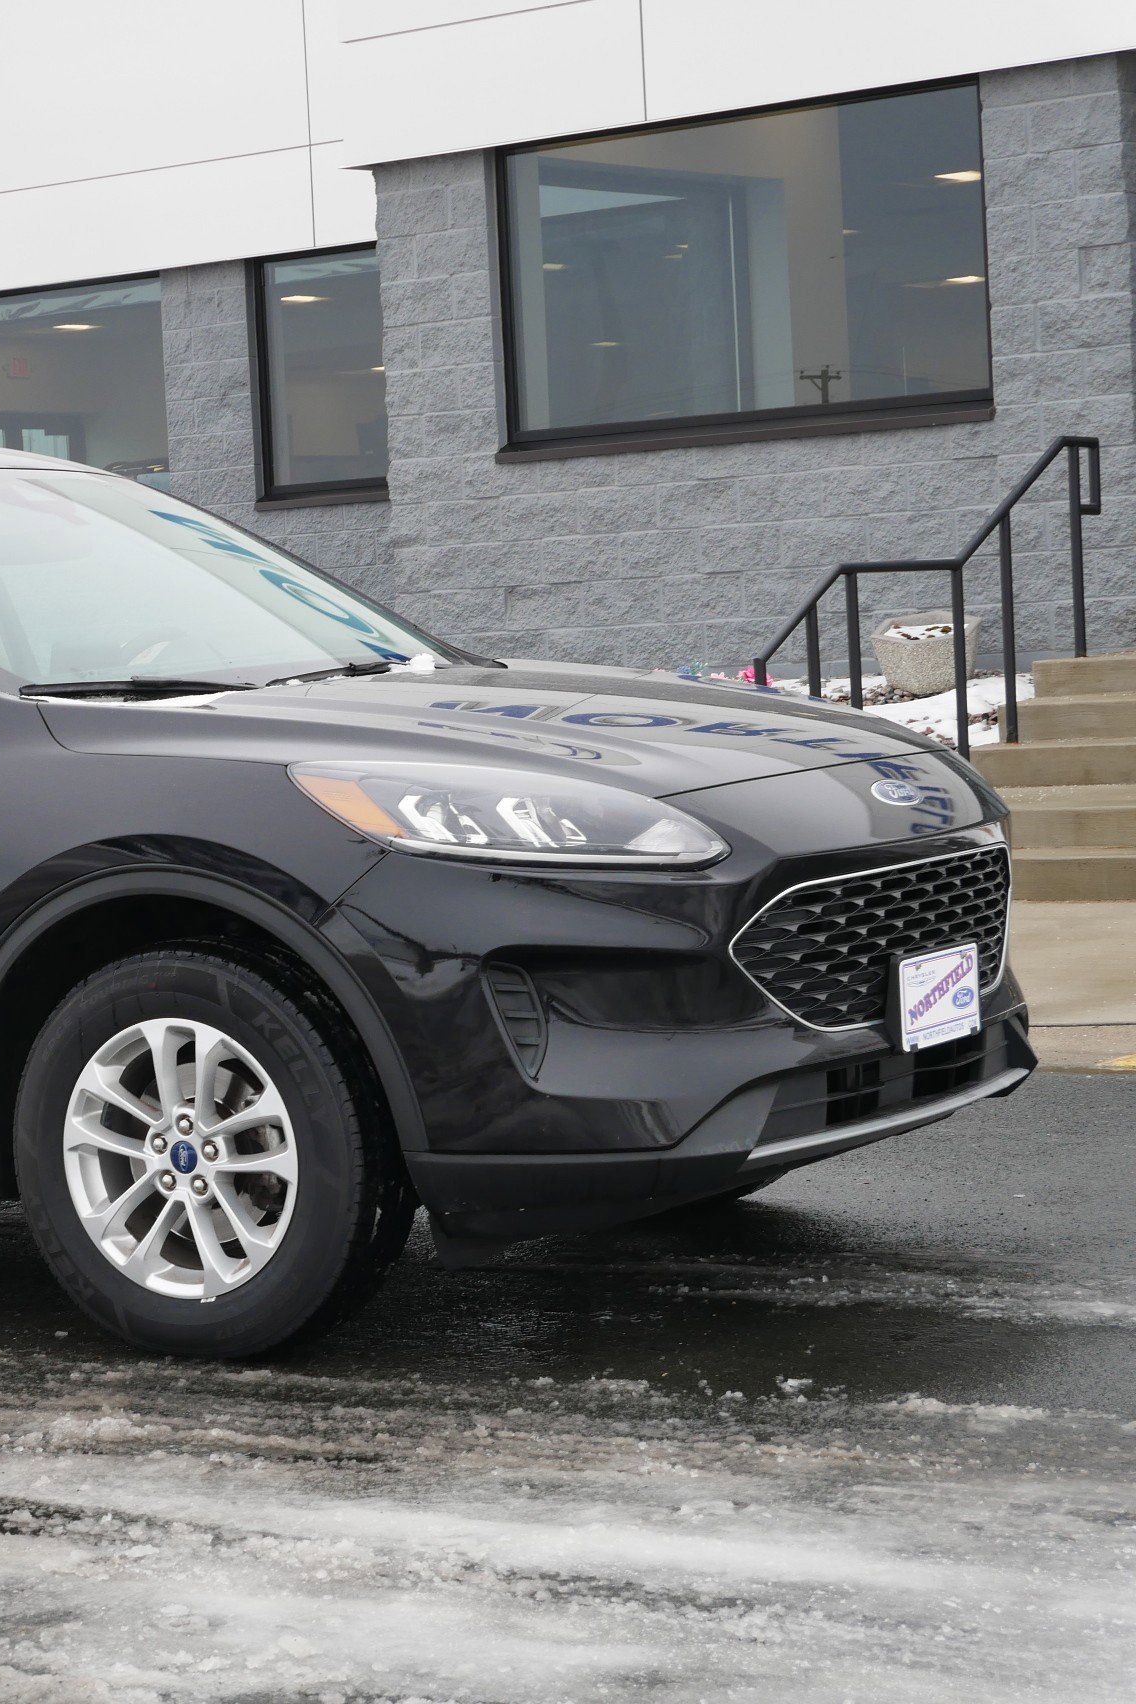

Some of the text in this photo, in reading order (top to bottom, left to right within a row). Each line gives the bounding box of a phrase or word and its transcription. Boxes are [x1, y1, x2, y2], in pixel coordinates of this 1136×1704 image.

[885, 783, 915, 799] Ford
[906, 970, 936, 981] CHRYSLER
[908, 954, 973, 1026] NORTHFIELD
[956, 989, 971, 1006] Ford
[251, 1010, 329, 1130] KELLY
